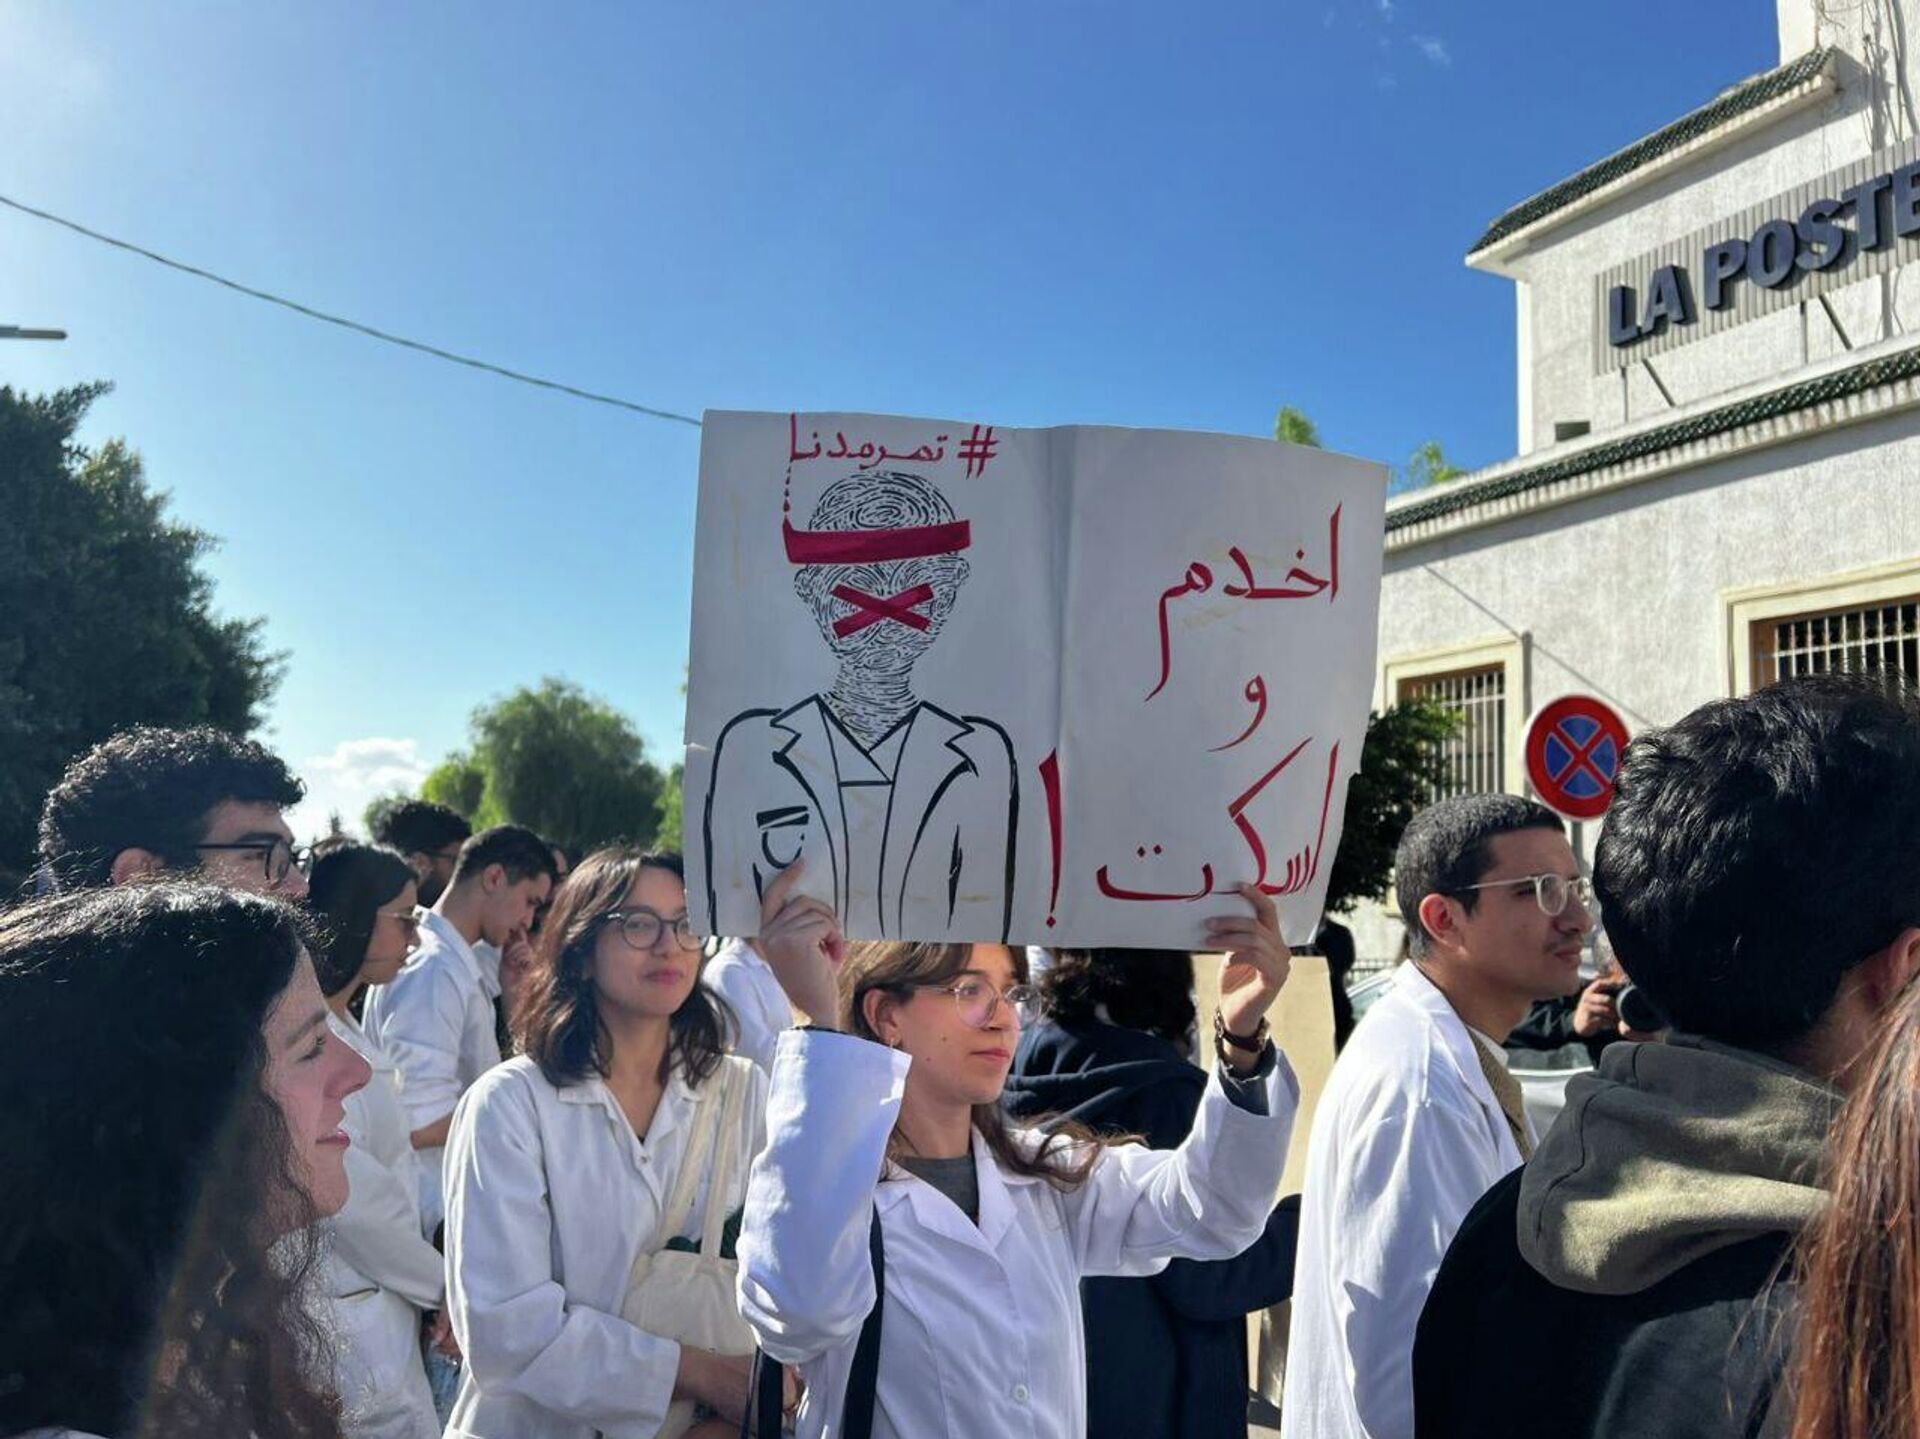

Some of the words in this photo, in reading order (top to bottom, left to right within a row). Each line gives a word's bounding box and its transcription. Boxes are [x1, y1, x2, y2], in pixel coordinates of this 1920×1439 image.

[1609, 264, 1695, 345] LA
[1703, 159, 1920, 310] POSTE
[1144, 502, 1342, 703] اخدم
[1207, 674, 1267, 752] و
